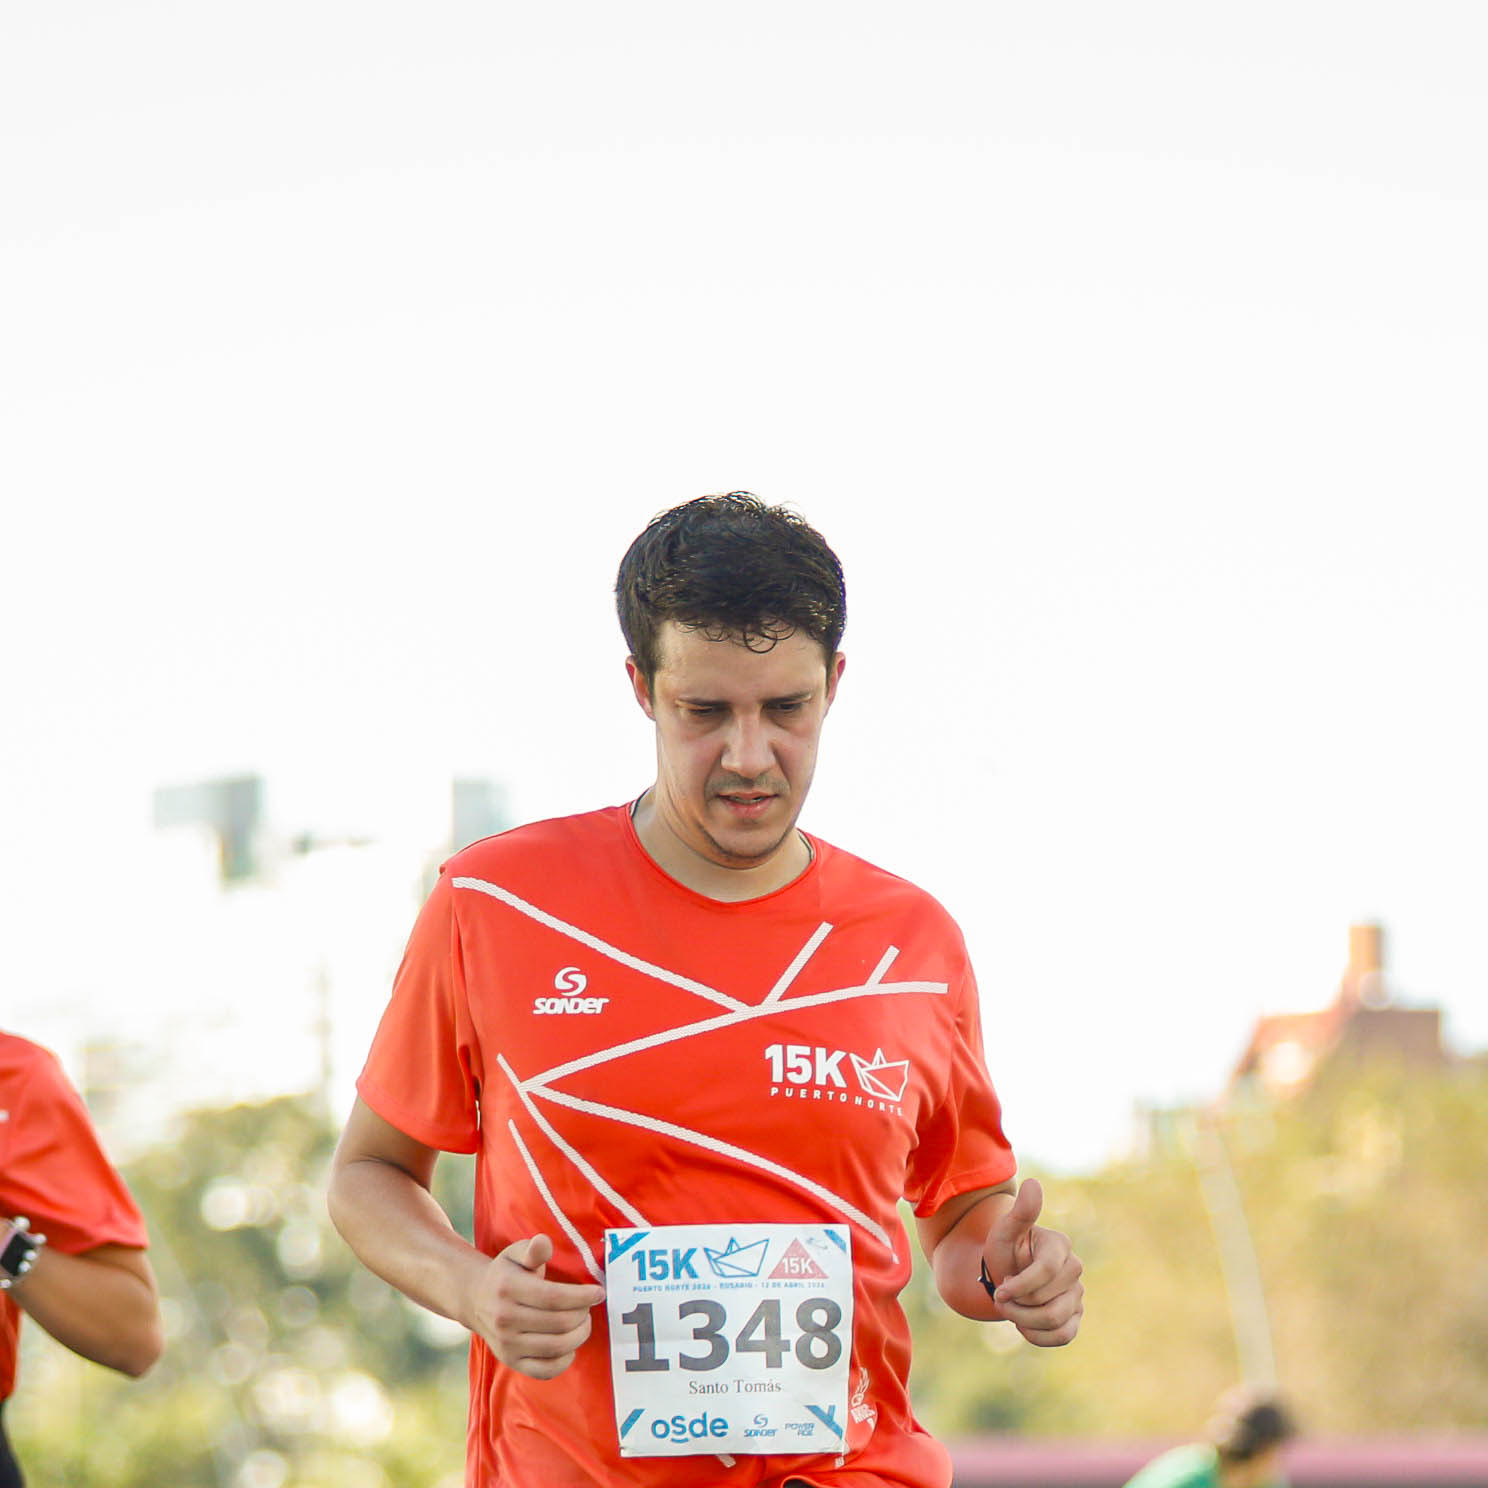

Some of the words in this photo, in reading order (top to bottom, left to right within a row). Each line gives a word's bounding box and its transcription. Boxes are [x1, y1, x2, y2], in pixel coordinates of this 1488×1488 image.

[764, 1043, 848, 1088] 15K
[770, 1087, 848, 1103] PUERTO
[854, 1095, 904, 1117] NORTE
[631, 1248, 699, 1281] 15K
[781, 1256, 814, 1275] 15K
[632, 1285, 663, 1293] PUERTO
[665, 1283, 690, 1292] NORTE
[719, 1281, 753, 1289] ROSARIO
[784, 1281, 805, 1289] ABRIL
[622, 1297, 842, 1372] 1348
[688, 1380, 729, 1395] Santo
[734, 1378, 782, 1394] Tomás
[651, 1411, 729, 1441] osde
